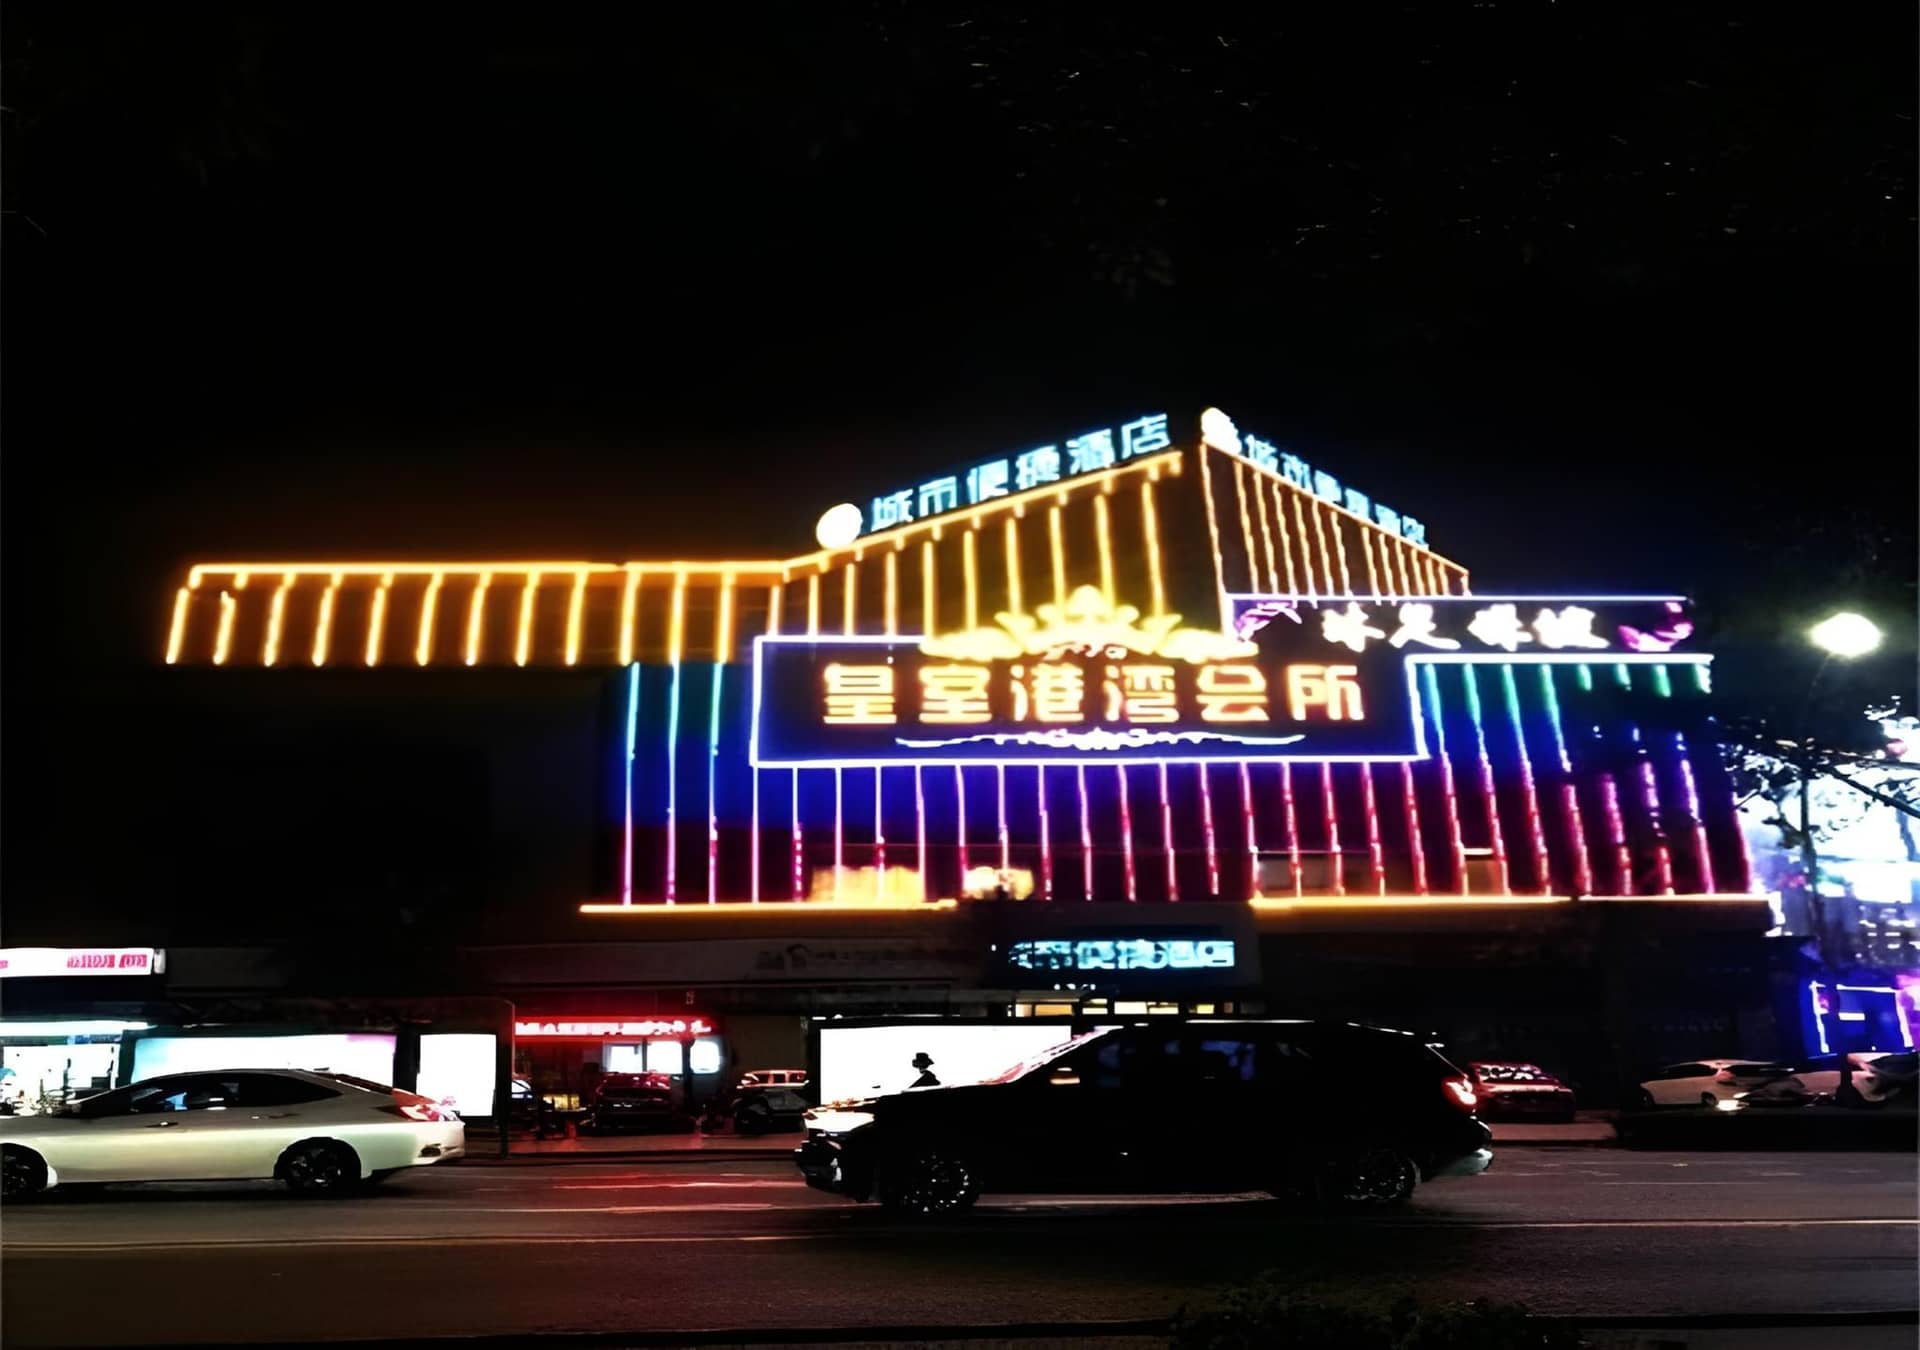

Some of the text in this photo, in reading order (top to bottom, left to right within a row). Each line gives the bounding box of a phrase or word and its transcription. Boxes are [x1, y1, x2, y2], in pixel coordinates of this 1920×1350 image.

[871, 413, 1171, 532] 城市便捷酒店
[1244, 434, 1429, 551] 城市店
[823, 663, 1365, 724] 皇室港湾会所
